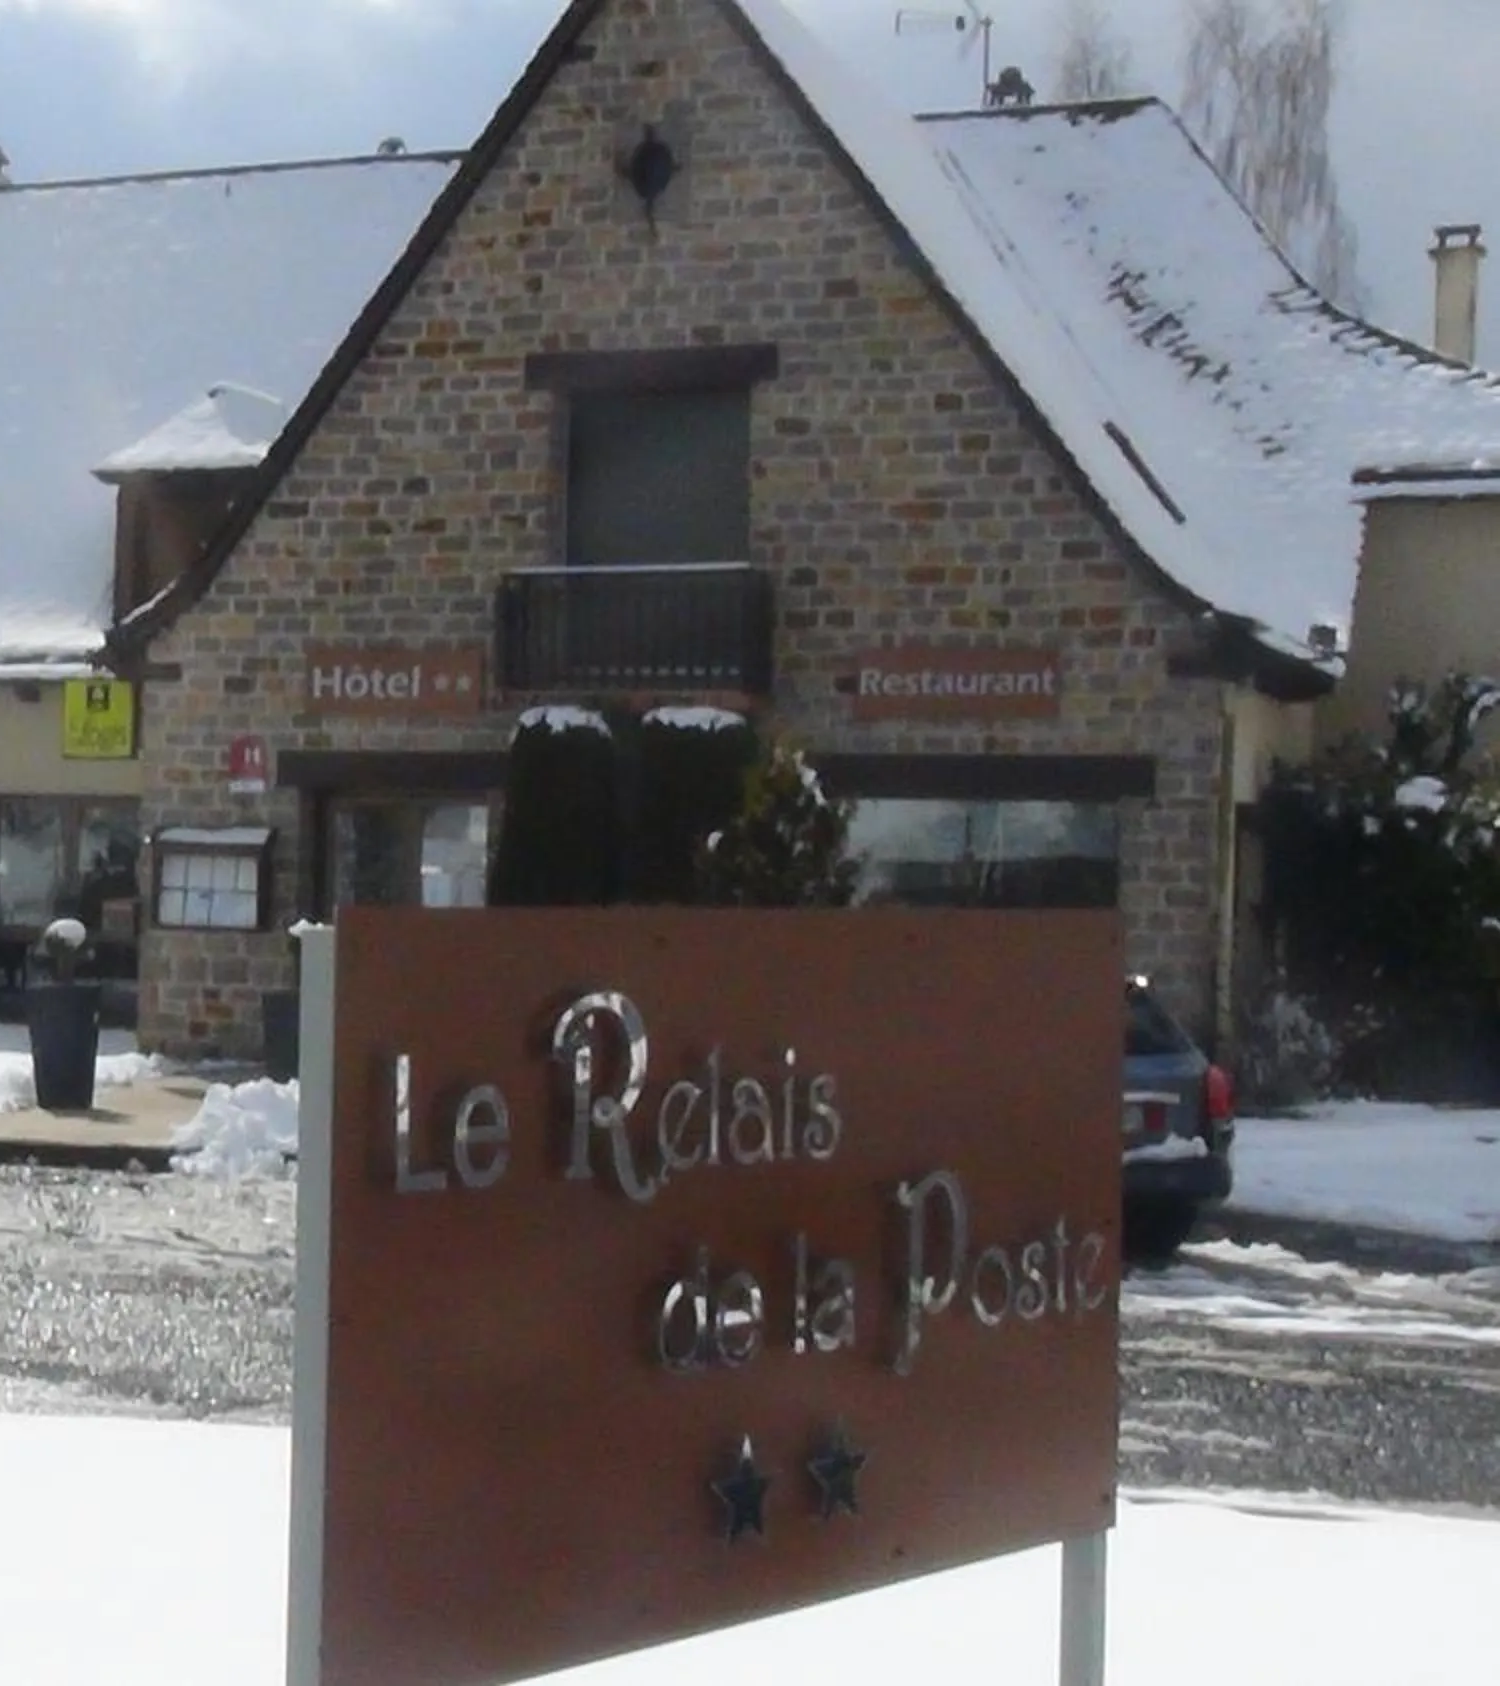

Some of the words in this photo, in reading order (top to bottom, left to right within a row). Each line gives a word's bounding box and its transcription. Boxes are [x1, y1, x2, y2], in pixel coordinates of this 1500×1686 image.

[312, 664, 421, 699] Hôtel
[859, 667, 1056, 696] Restaurant
[394, 1053, 511, 1194] Le
[552, 990, 843, 1202] Relais
[656, 1245, 764, 1374] de
[792, 1234, 856, 1355] la
[892, 1168, 1108, 1377] Poste
